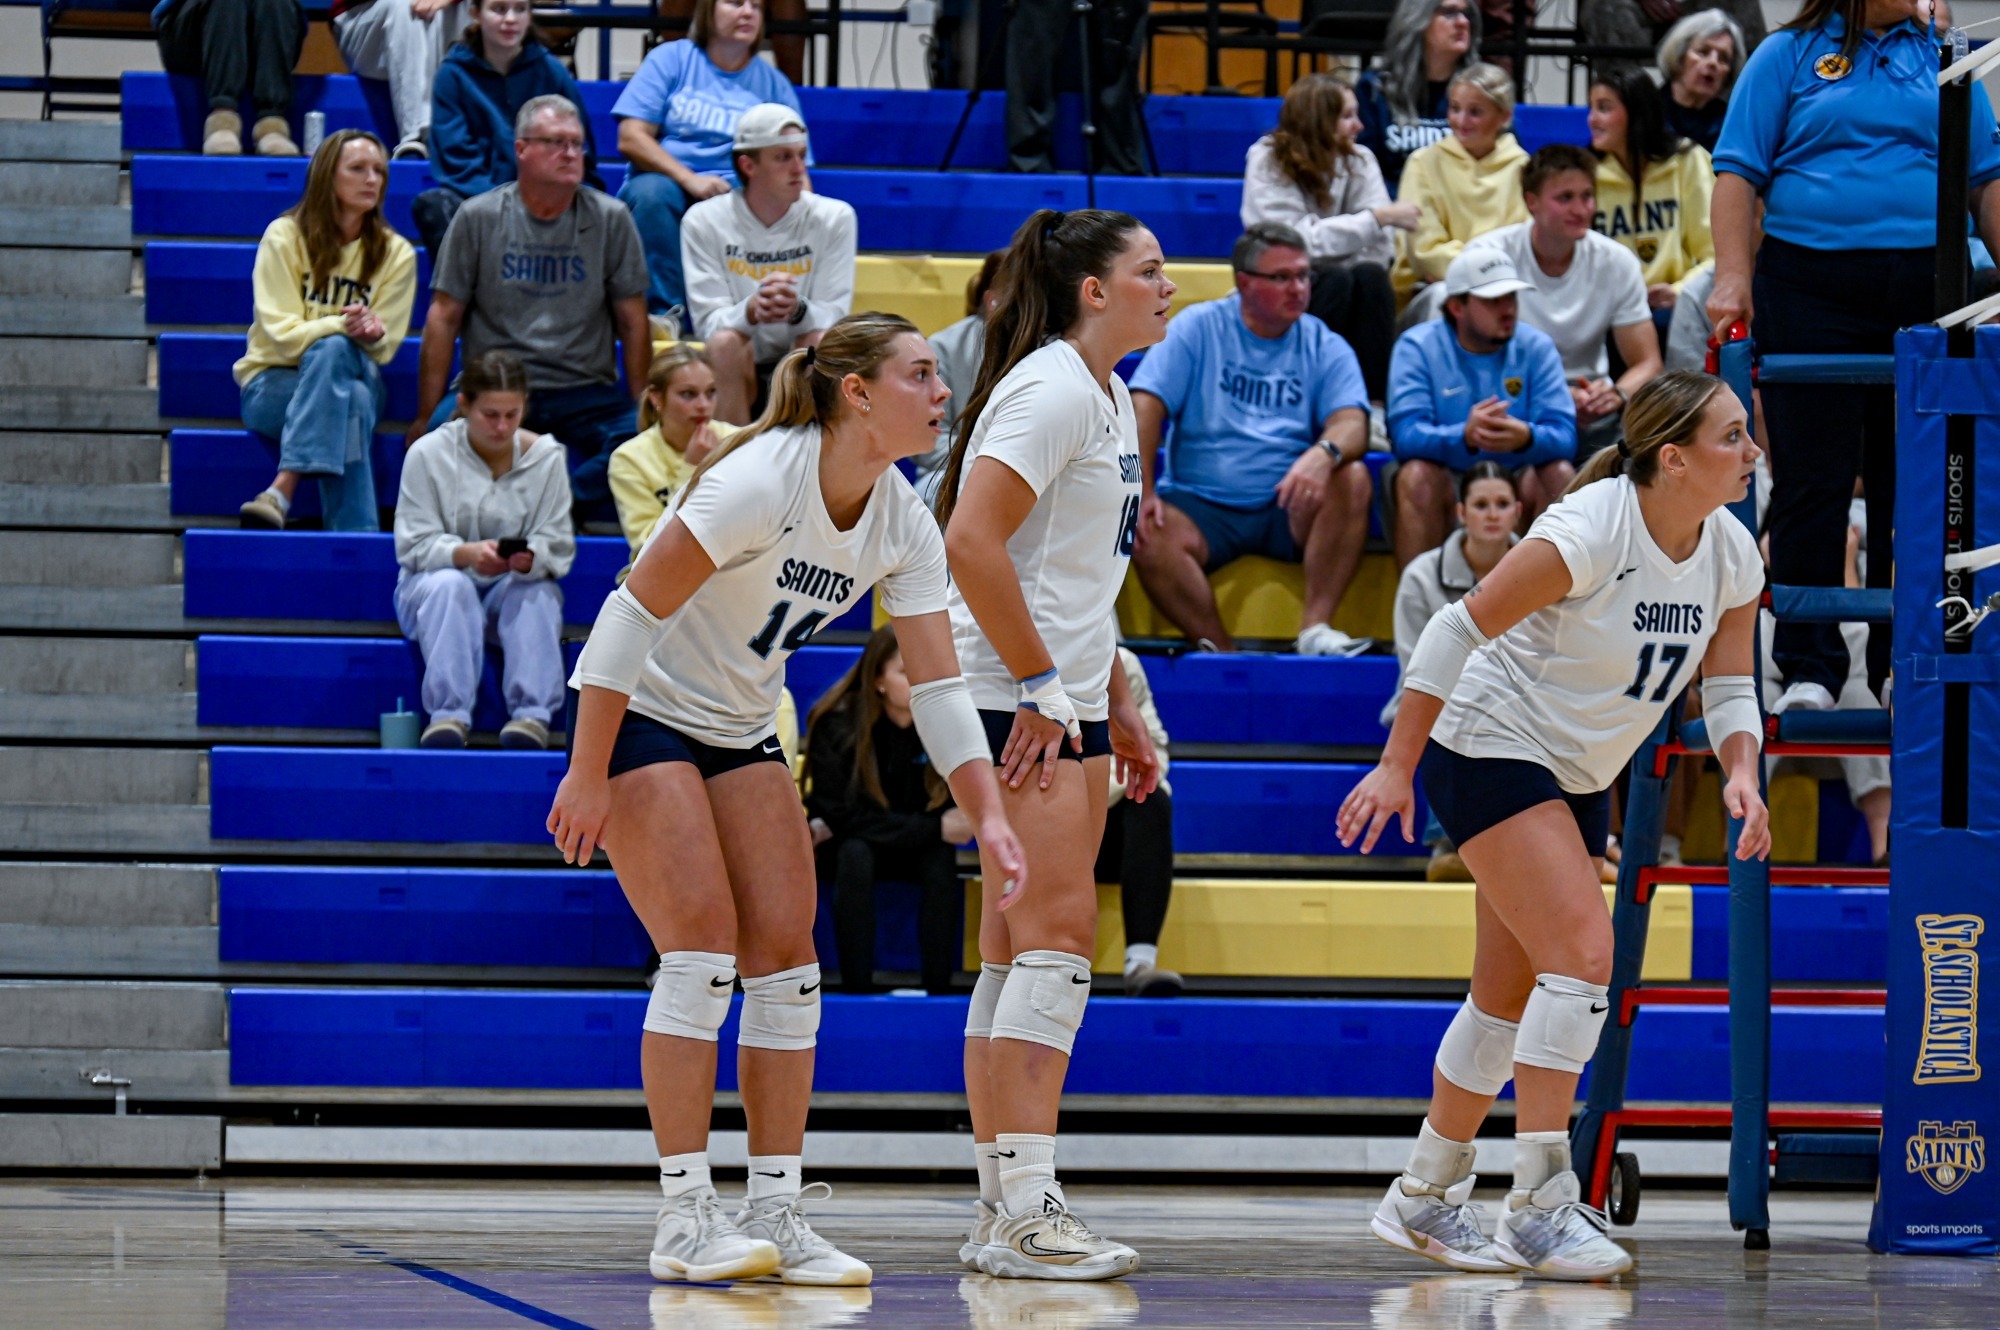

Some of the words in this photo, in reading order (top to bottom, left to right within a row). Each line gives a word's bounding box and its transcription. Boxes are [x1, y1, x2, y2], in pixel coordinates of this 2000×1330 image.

[501, 252, 588, 283] SAINTS
[744, 244, 813, 263] CHOLASTICA
[1219, 366, 1303, 407] SAINTS
[1948, 453, 1964, 526] sports
[1113, 493, 1140, 557] 18
[776, 557, 854, 604] SAINTS
[747, 599, 830, 661] 14
[1632, 600, 1703, 635] SAINTS
[1622, 641, 1690, 703] 17
[1919, 917, 1981, 947] ST.
[1915, 951, 1980, 1081] SCHOLASTICA
[1908, 1139, 1982, 1171] SAINTS
[1906, 1224, 1940, 1236] sports
[1941, 1224, 1983, 1236] imports
